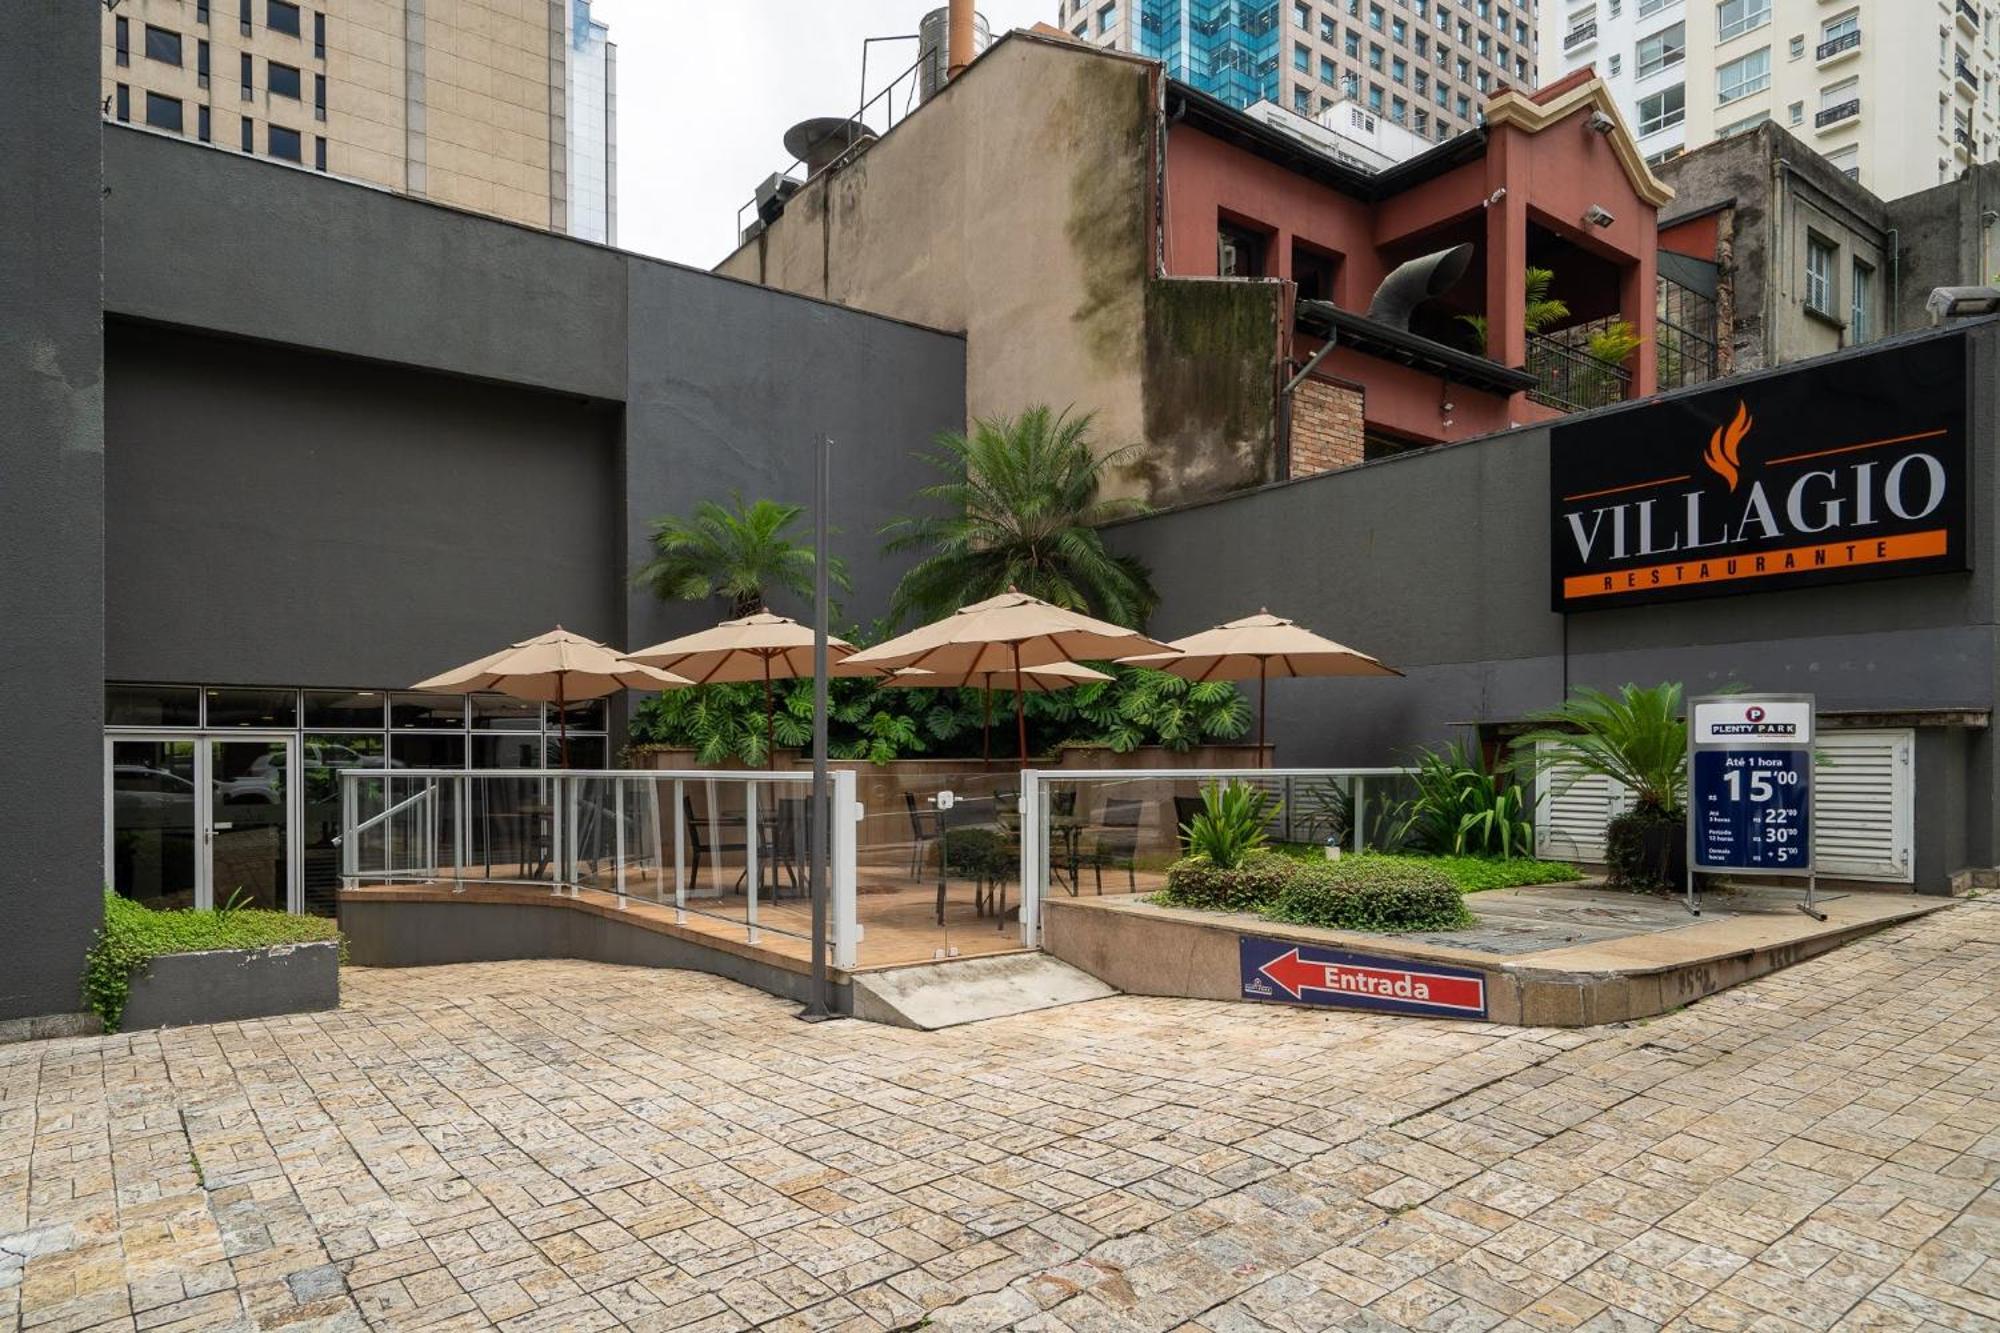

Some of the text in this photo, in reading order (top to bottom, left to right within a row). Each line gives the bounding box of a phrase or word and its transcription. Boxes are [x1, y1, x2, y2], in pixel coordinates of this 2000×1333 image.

[1563, 453, 1947, 564] VILLAGIO
[1604, 541, 1887, 591] RESTAURANTE
[1713, 725, 1794, 733] PLENTY PARK
[1726, 757, 1783, 767] Até 1 hora
[1324, 967, 1430, 1000] Entrada
